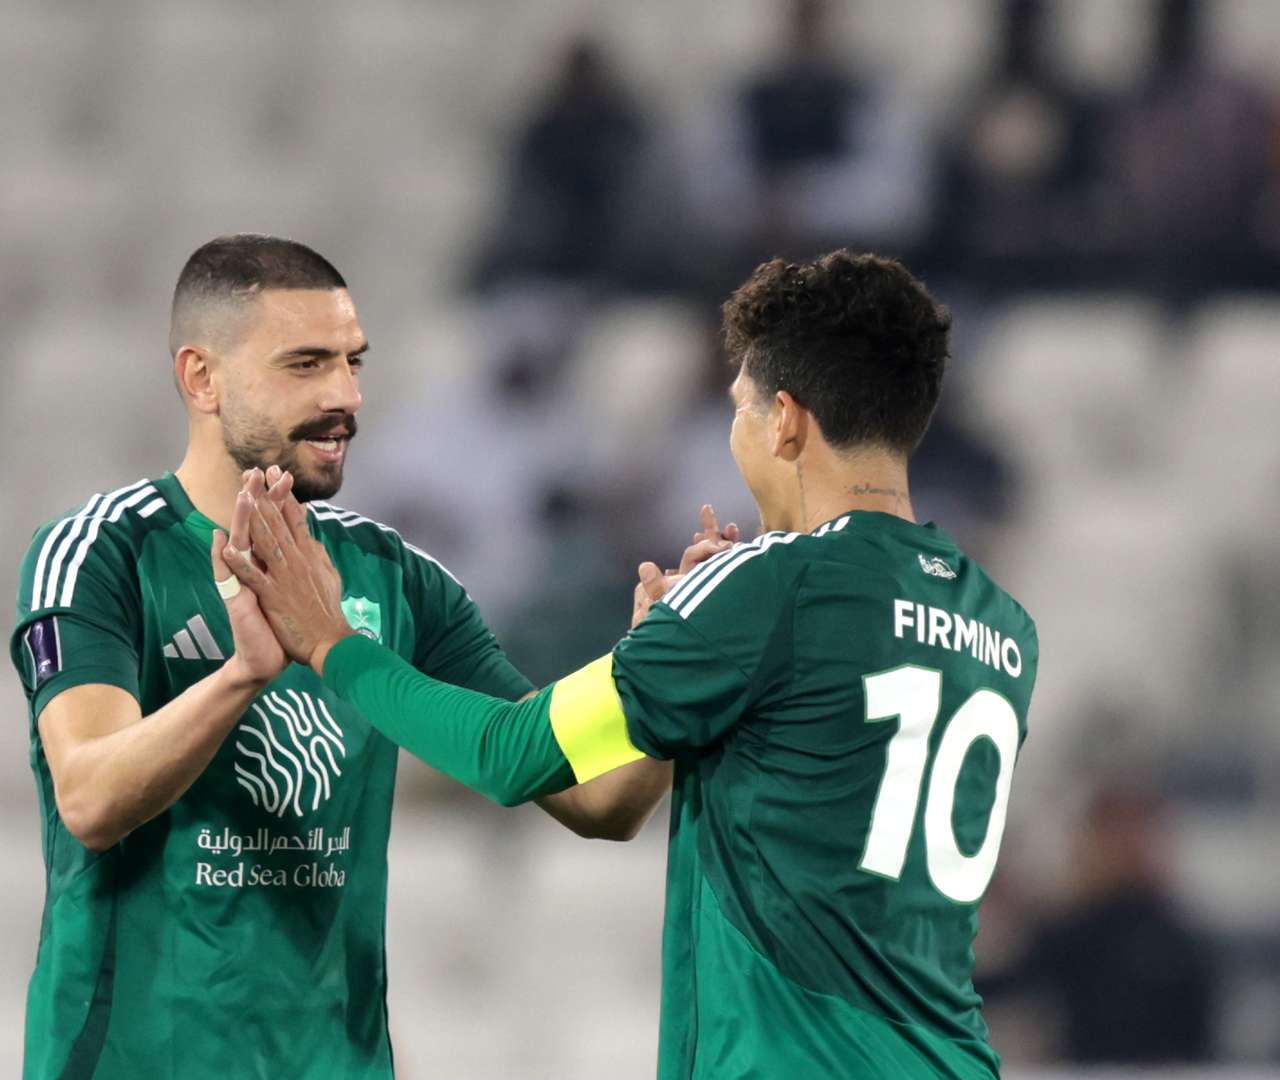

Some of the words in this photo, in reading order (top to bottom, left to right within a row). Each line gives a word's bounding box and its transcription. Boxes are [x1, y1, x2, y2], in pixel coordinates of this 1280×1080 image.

[894, 598, 1022, 678] FIRMINO
[859, 665, 1019, 903] 10
[197, 827, 269, 857] الدولية
[269, 827, 323, 855] الأحمر
[195, 862, 244, 887] Red
[247, 864, 287, 886] Sea
